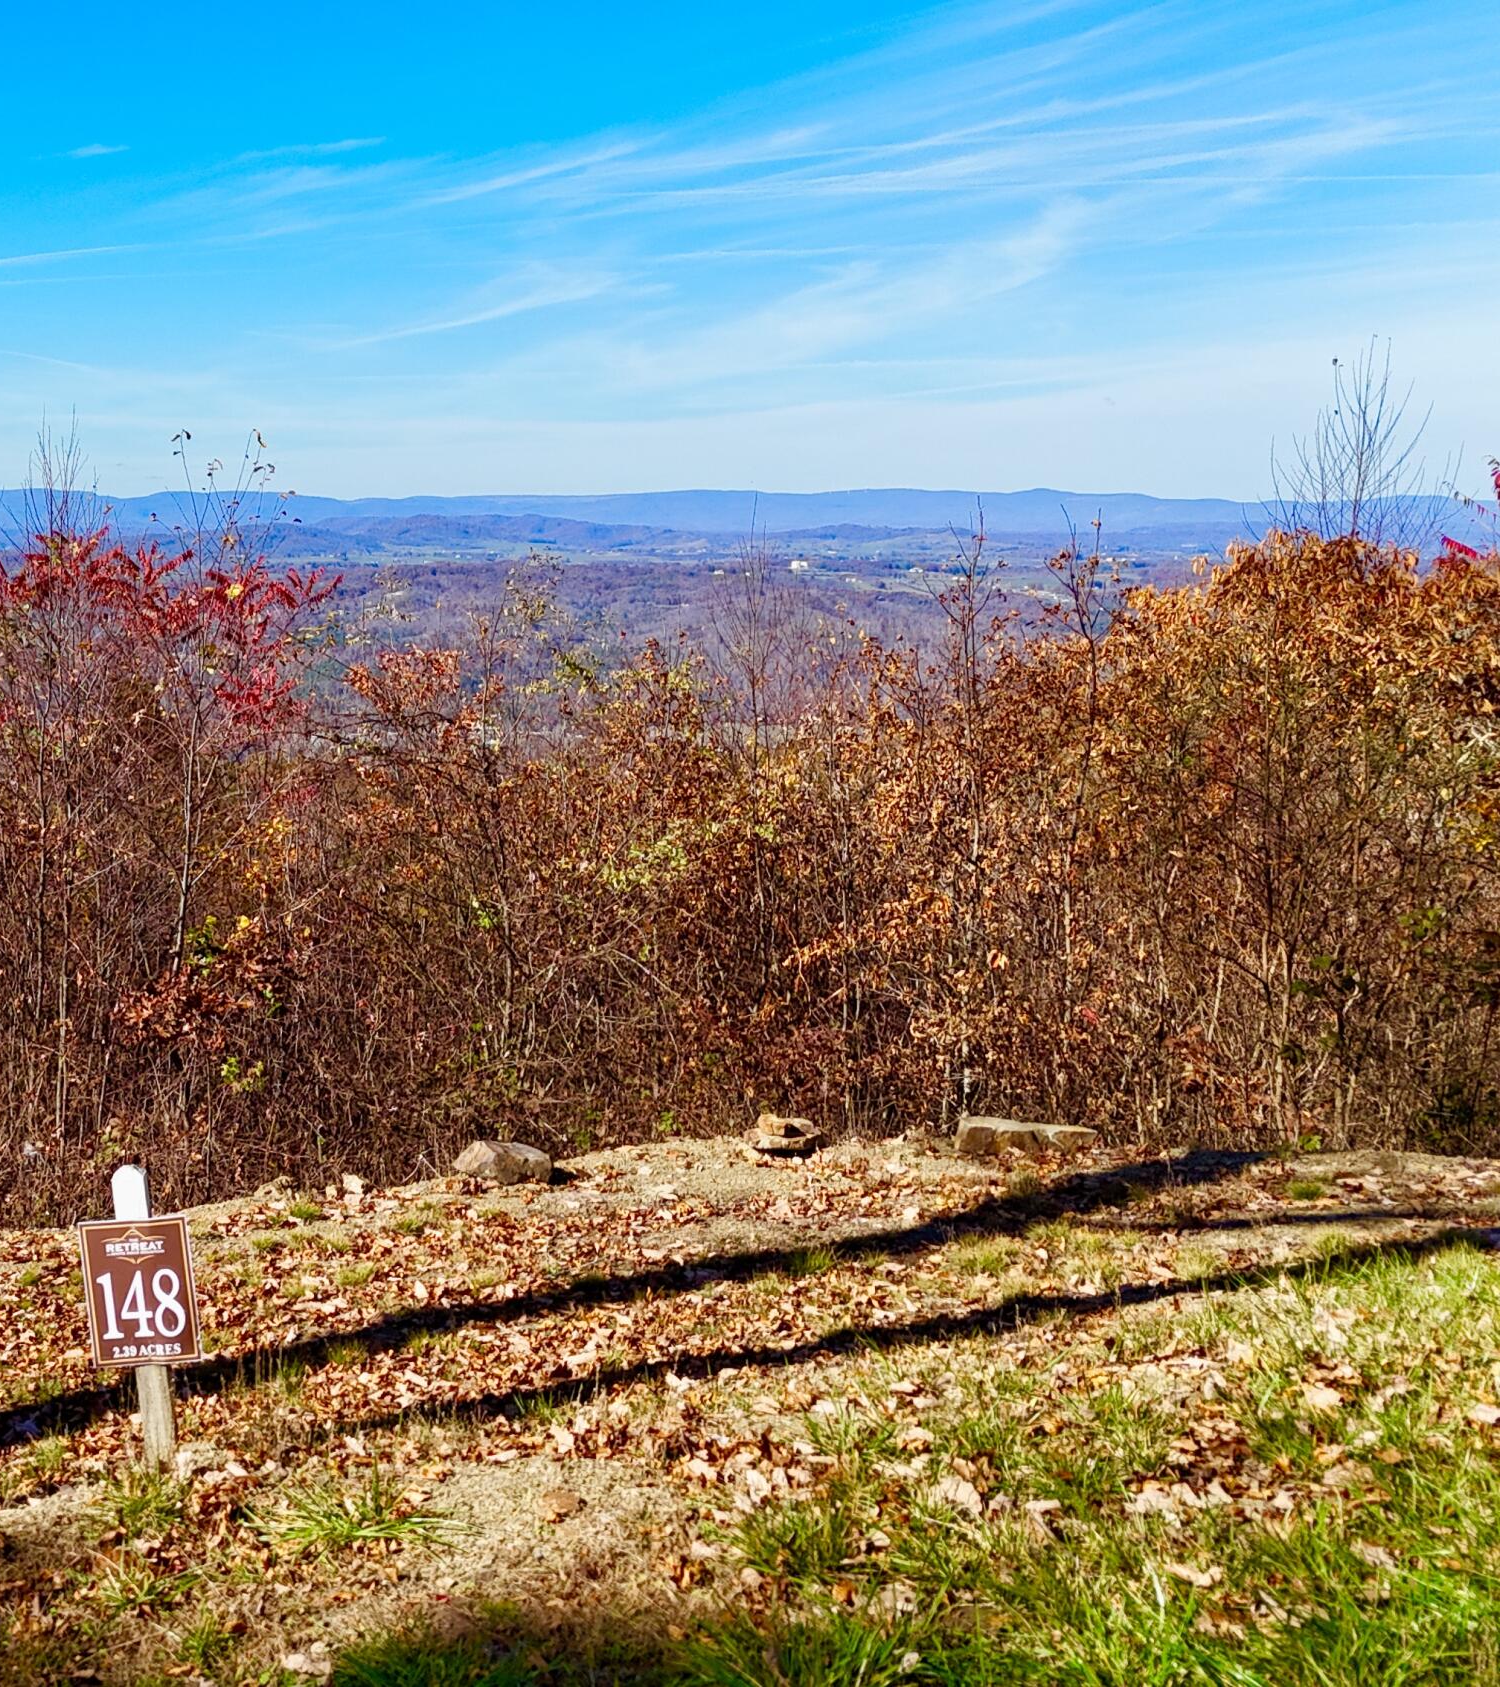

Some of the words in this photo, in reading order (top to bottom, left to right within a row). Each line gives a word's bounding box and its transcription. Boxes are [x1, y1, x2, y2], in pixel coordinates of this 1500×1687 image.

[105, 1240, 164, 1253] RETREAT
[96, 1268, 186, 1340] 148
[112, 1345, 138, 1358] 2.39
[138, 1343, 182, 1356] ACRES
